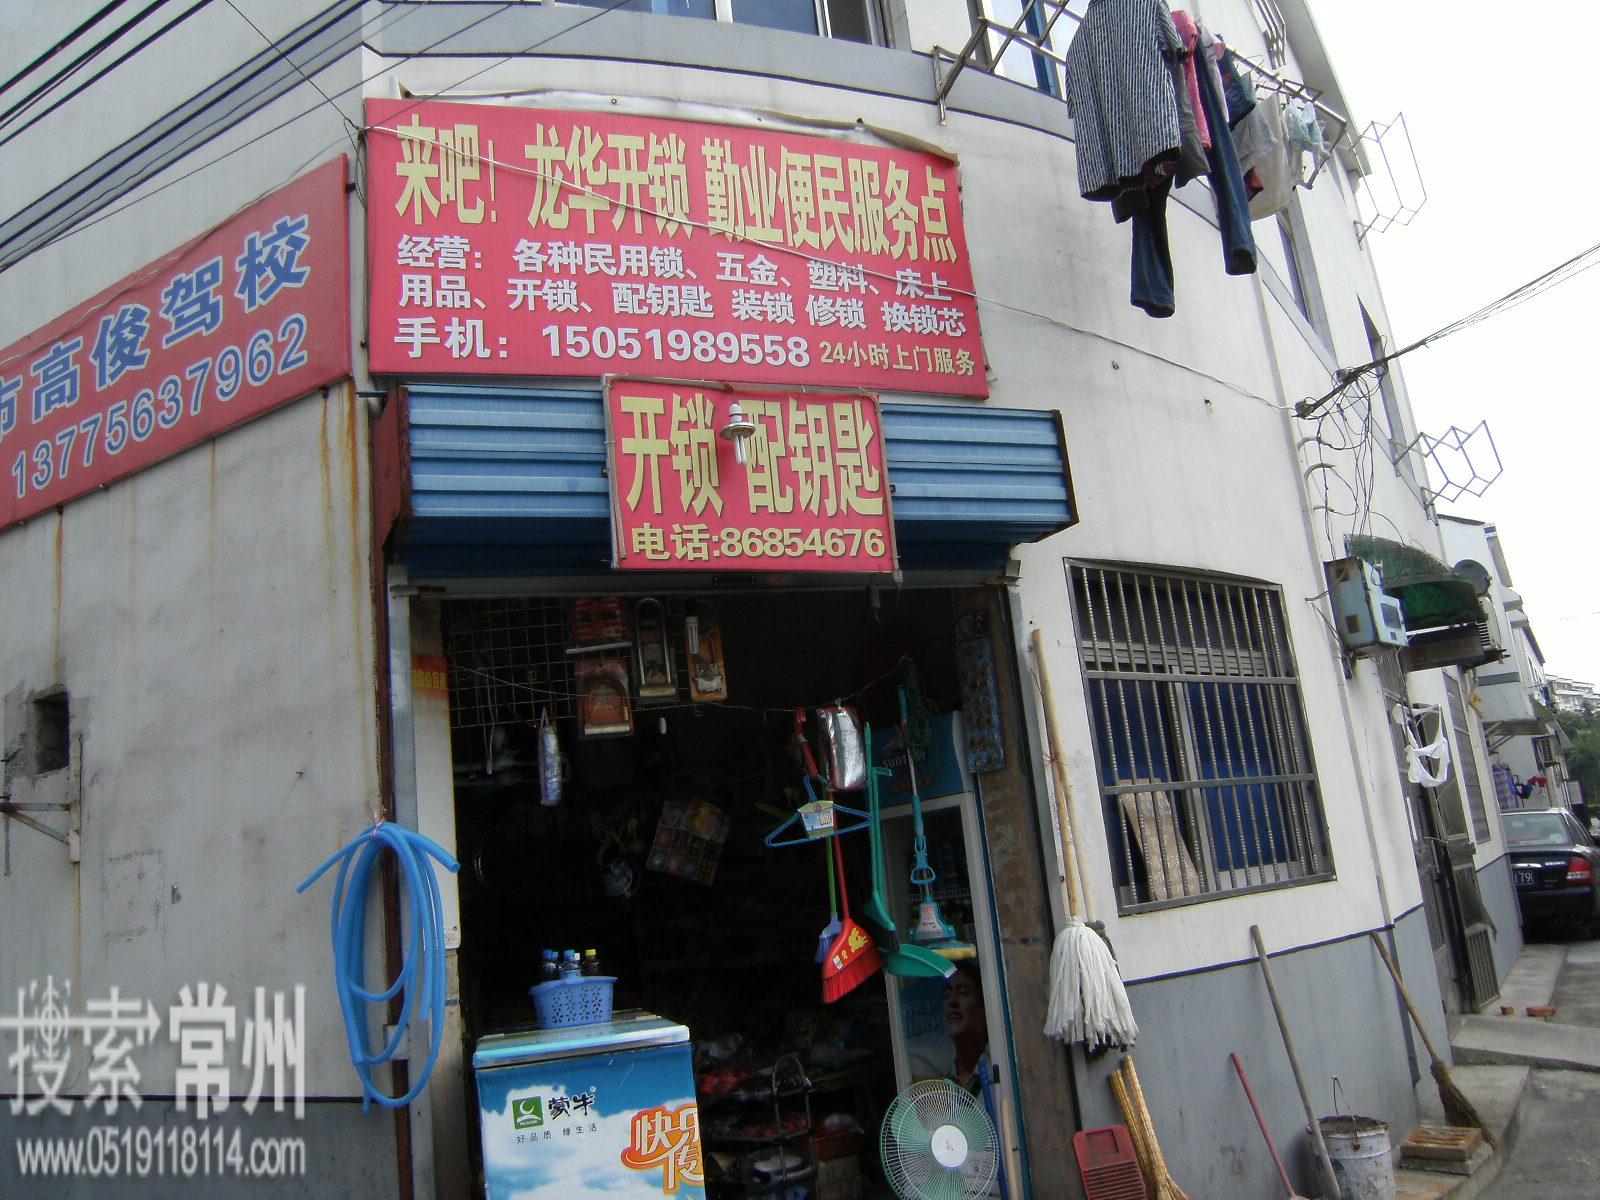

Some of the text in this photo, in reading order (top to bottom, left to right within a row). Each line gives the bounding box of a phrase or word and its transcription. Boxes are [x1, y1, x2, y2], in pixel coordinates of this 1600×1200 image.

[394, 113, 965, 264] 来吧! 龙华开锁 勤业便民服务点
[396, 235, 483, 273] 经营：
[394, 317, 811, 368] 手机： 15051989558
[818, 340, 976, 377] 24小时上门服务
[12, 313, 308, 499] 13775637962
[620, 392, 884, 517] 开锁 配钥匙
[547, 1092, 596, 1120] 蒙牛
